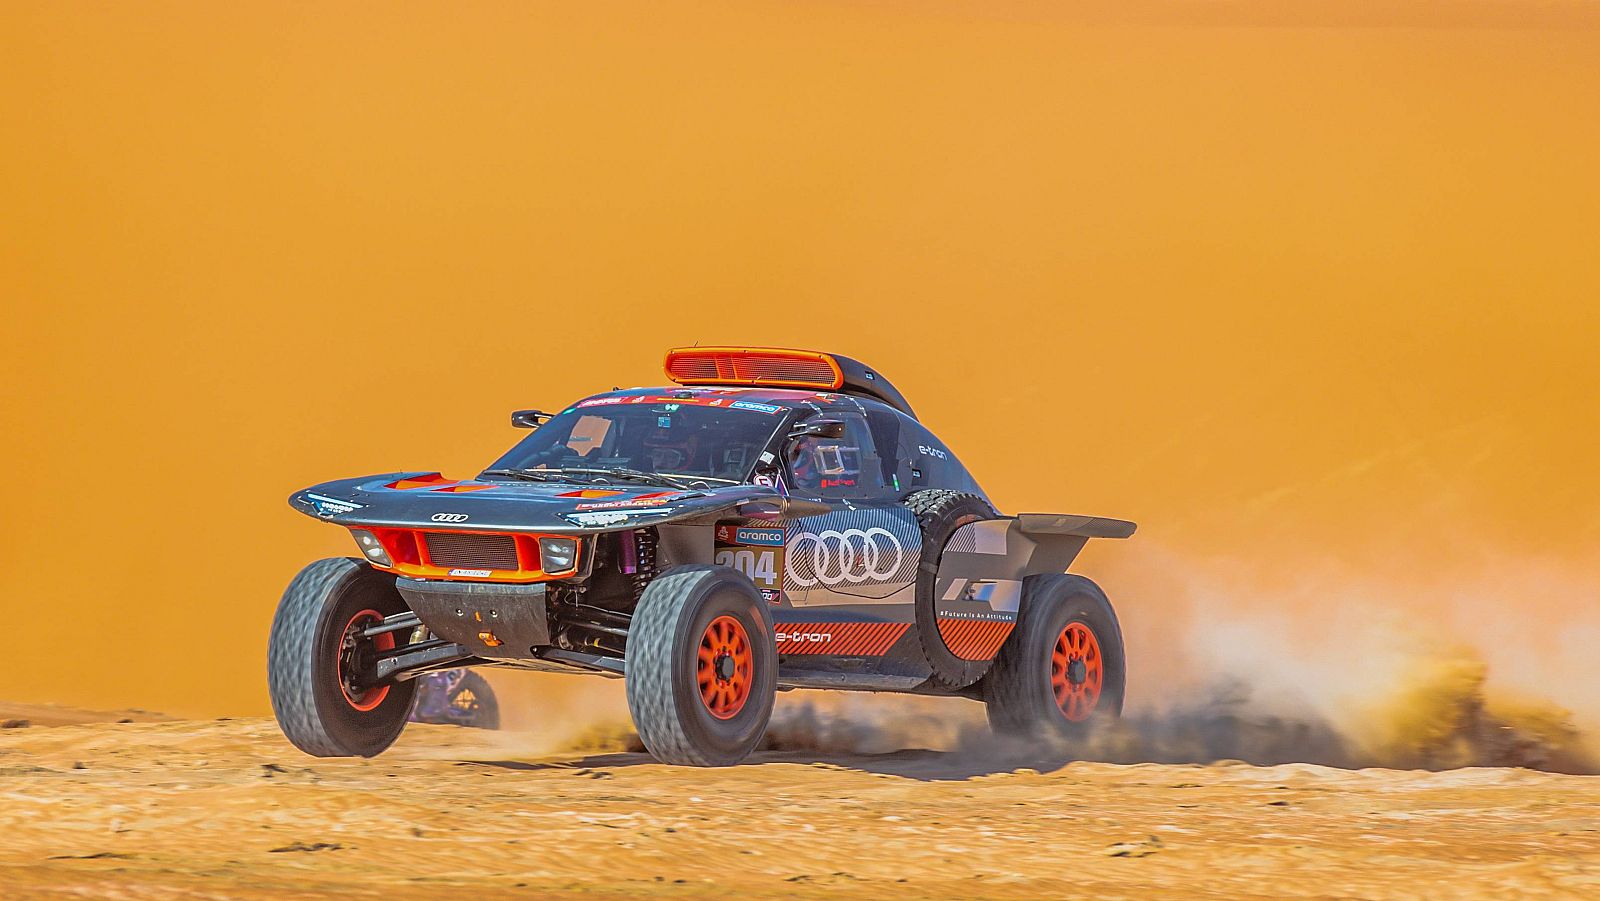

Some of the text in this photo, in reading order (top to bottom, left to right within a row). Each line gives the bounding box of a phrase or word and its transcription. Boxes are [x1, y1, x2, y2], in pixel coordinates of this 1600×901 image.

[734, 402, 776, 412] aramco
[918, 445, 948, 461] e-tron
[739, 531, 782, 541] aramco
[775, 631, 832, 642] e-tron
